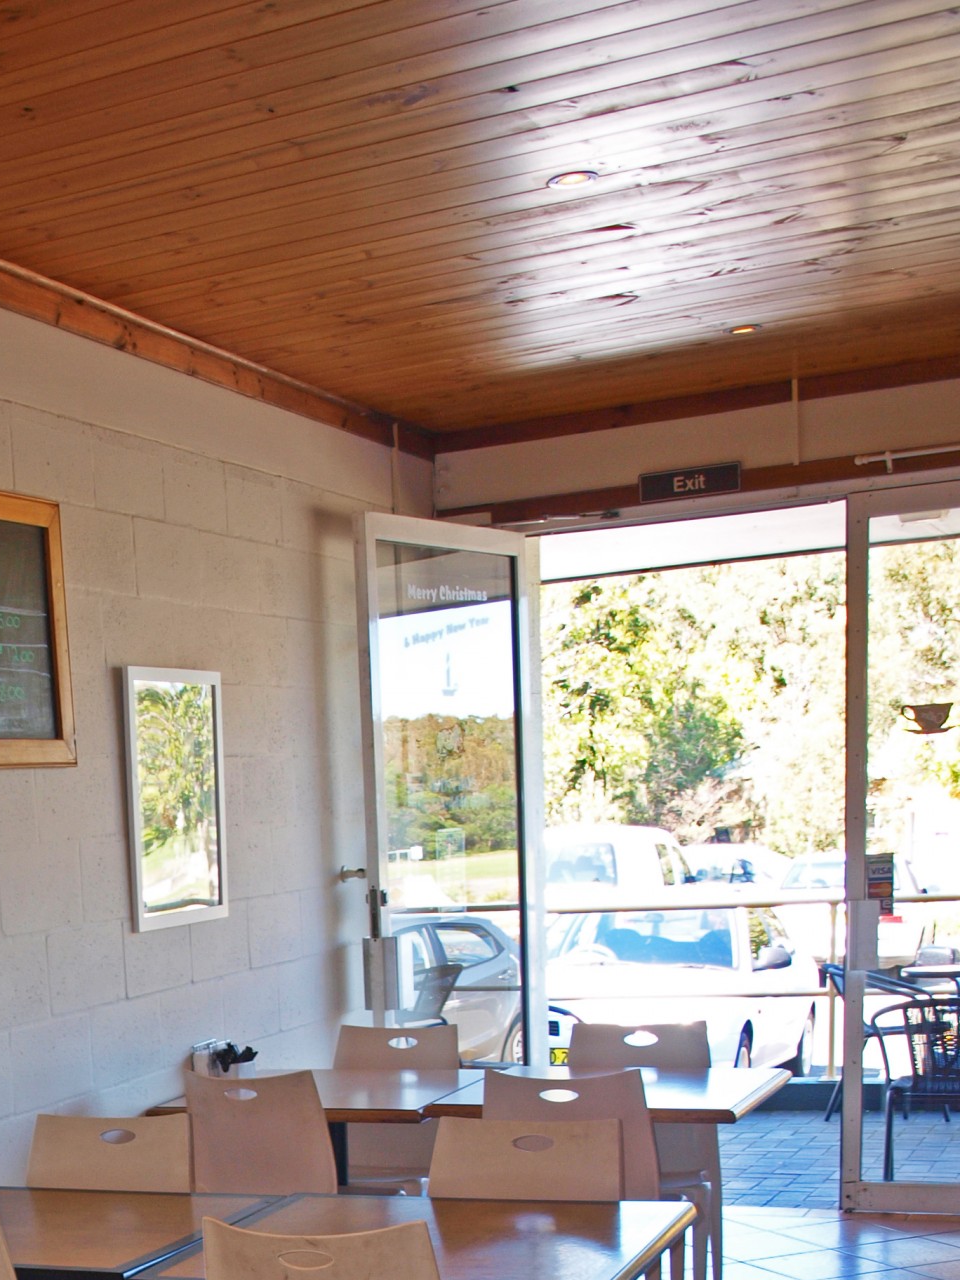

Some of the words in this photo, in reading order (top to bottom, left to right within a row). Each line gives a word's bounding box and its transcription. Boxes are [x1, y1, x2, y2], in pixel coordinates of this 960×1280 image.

[673, 474, 706, 492] Exit
[407, 583, 438, 602] Merry
[439, 585, 488, 602] Christmas
[412, 629, 444, 645] Happy
[446, 623, 467, 635] New
[468, 617, 490, 628] Year
[870, 866, 892, 876] VISA
